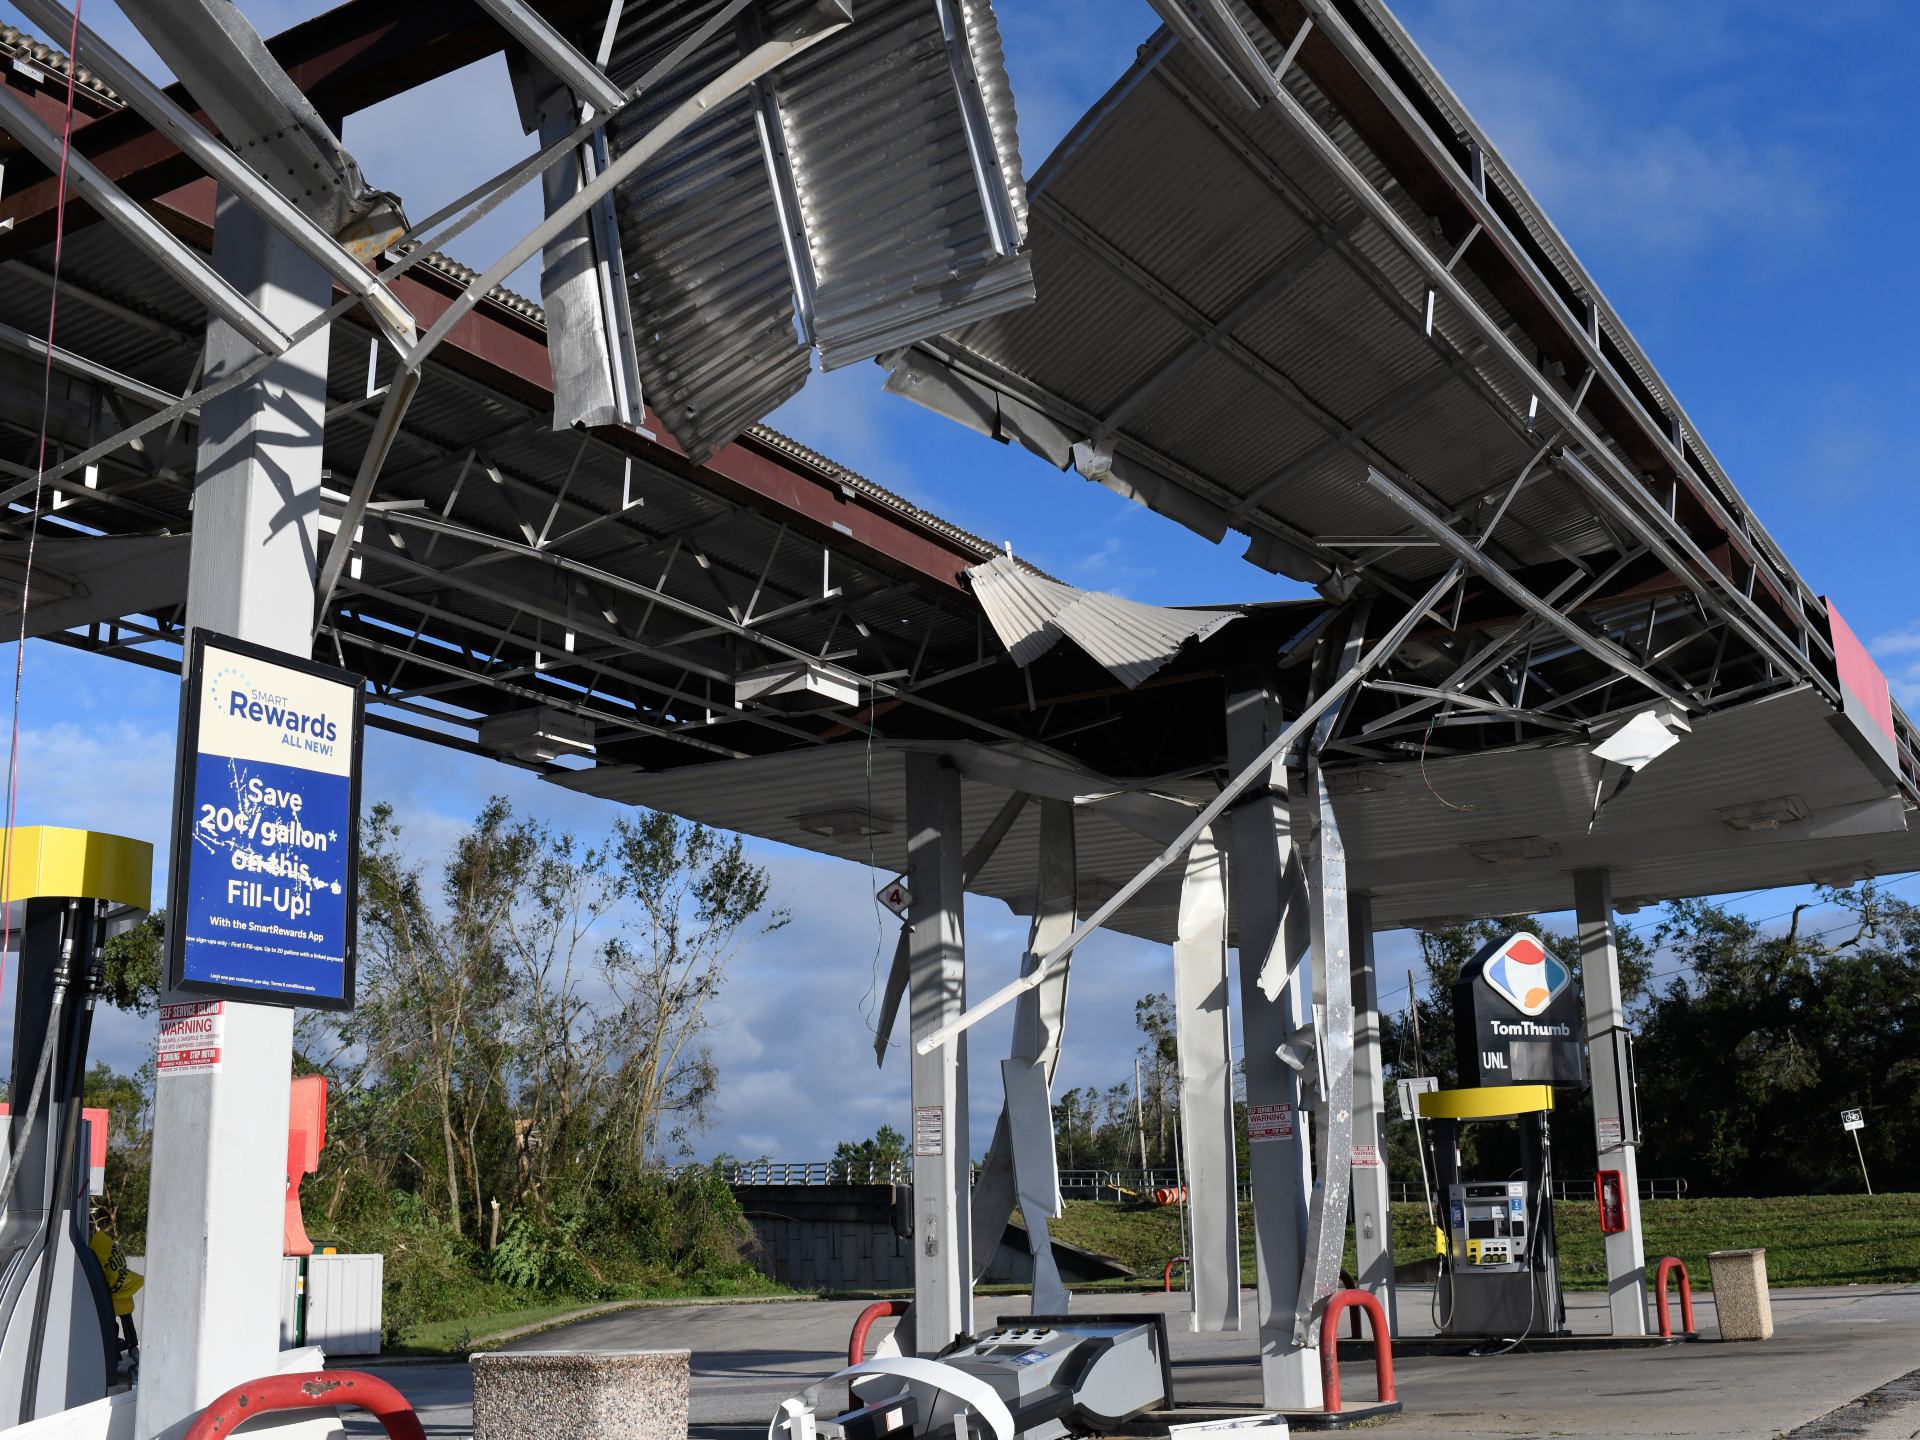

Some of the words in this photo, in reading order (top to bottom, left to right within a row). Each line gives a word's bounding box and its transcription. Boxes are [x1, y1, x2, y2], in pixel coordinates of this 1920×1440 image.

[251, 690, 288, 707] SMART
[229, 690, 337, 742] Rewards
[281, 733, 302, 749] ALL
[304, 739, 333, 757] NEW!
[248, 778, 303, 812] Save
[267, 852, 310, 882] this
[227, 879, 311, 920] Fill-Up!
[889, 889, 902, 905] 4
[209, 915, 231, 928] With
[233, 919, 247, 930] the
[248, 921, 307, 939] SmartRewards
[308, 931, 324, 943] App
[173, 1004, 196, 1018] SERVICE
[197, 1002, 220, 1016] ISLAND
[161, 1018, 212, 1036] WARNING
[1490, 1020, 1570, 1036] TomThumb
[1482, 1051, 1508, 1069] UNL
[1250, 1113, 1286, 1123] WARNING
